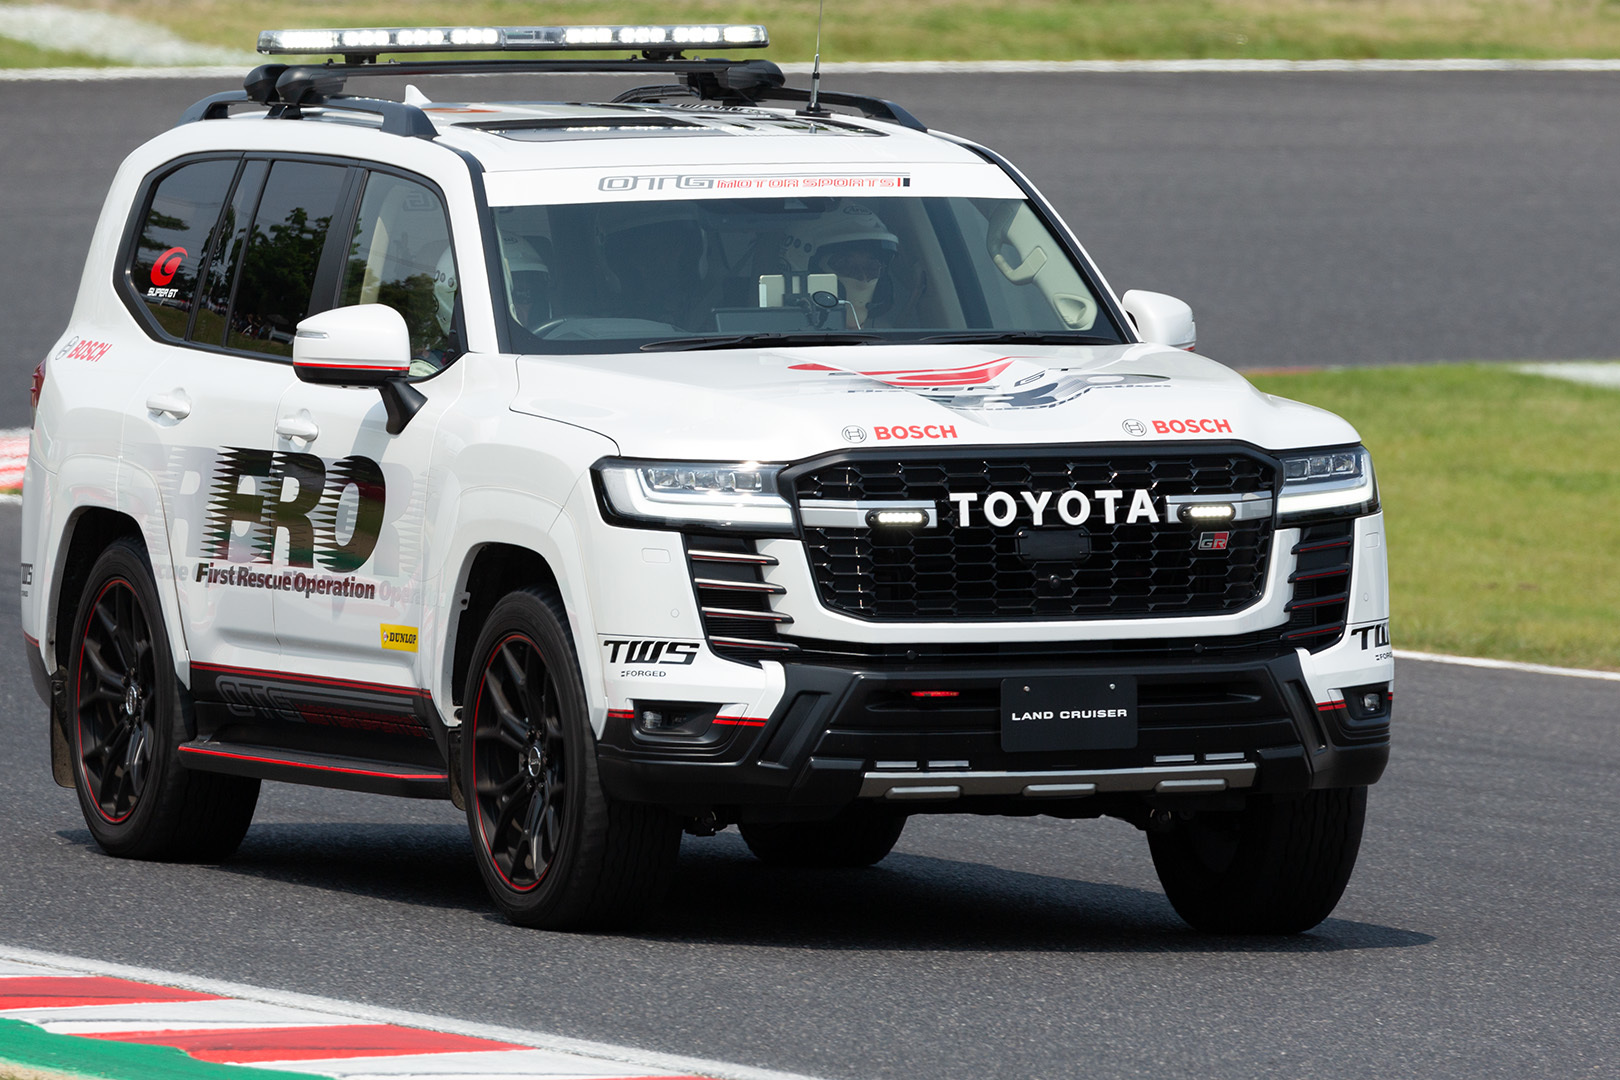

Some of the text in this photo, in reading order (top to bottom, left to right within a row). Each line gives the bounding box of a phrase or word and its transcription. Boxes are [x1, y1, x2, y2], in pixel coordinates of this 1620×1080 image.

[67, 340, 112, 362] BOSCH
[873, 425, 958, 440] BOSCH
[1152, 419, 1233, 434] BOSCH
[949, 489, 1160, 528] TOYOTA
[1200, 538, 1226, 548] GR
[195, 562, 235, 587] First
[236, 566, 292, 593] Rescue
[293, 572, 376, 600] Operation
[389, 632, 417, 644] DUNLOP
[603, 640, 700, 665] TWS
[625, 670, 667, 678] FORGED
[1011, 709, 1128, 721] LAND CRUISER
